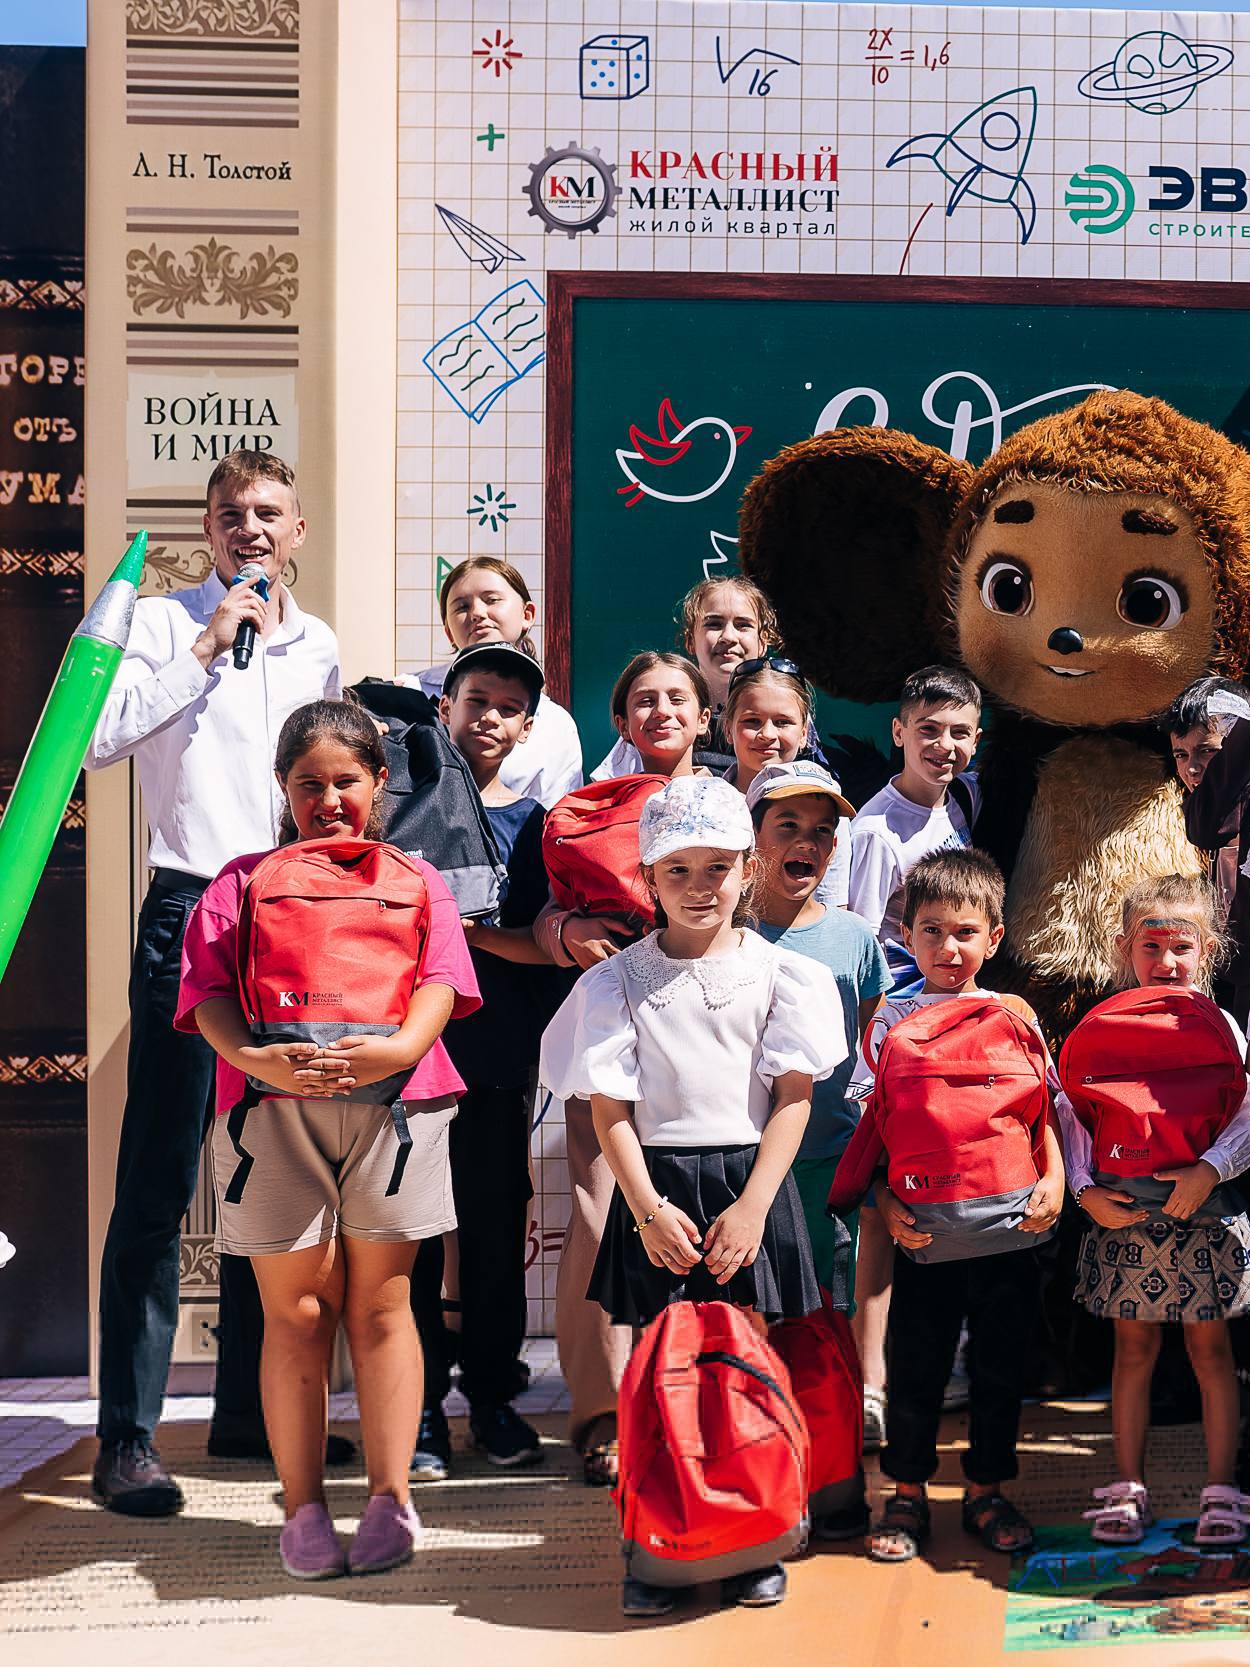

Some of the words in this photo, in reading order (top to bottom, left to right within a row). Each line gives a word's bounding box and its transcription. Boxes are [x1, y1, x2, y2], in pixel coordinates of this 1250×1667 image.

[132, 151, 158, 177] Л.
[167, 153, 195, 179] Н.
[203, 153, 292, 181] Толстой
[629, 145, 840, 183] КРАСНЫЙ
[629, 186, 840, 214] МЕТАЛЛИСТ
[629, 216, 714, 234] жилой
[727, 219, 836, 239] квартал
[143, 392, 282, 426] ВОЙНА
[151, 433, 177, 461] И
[191, 434, 274, 461] МИР
